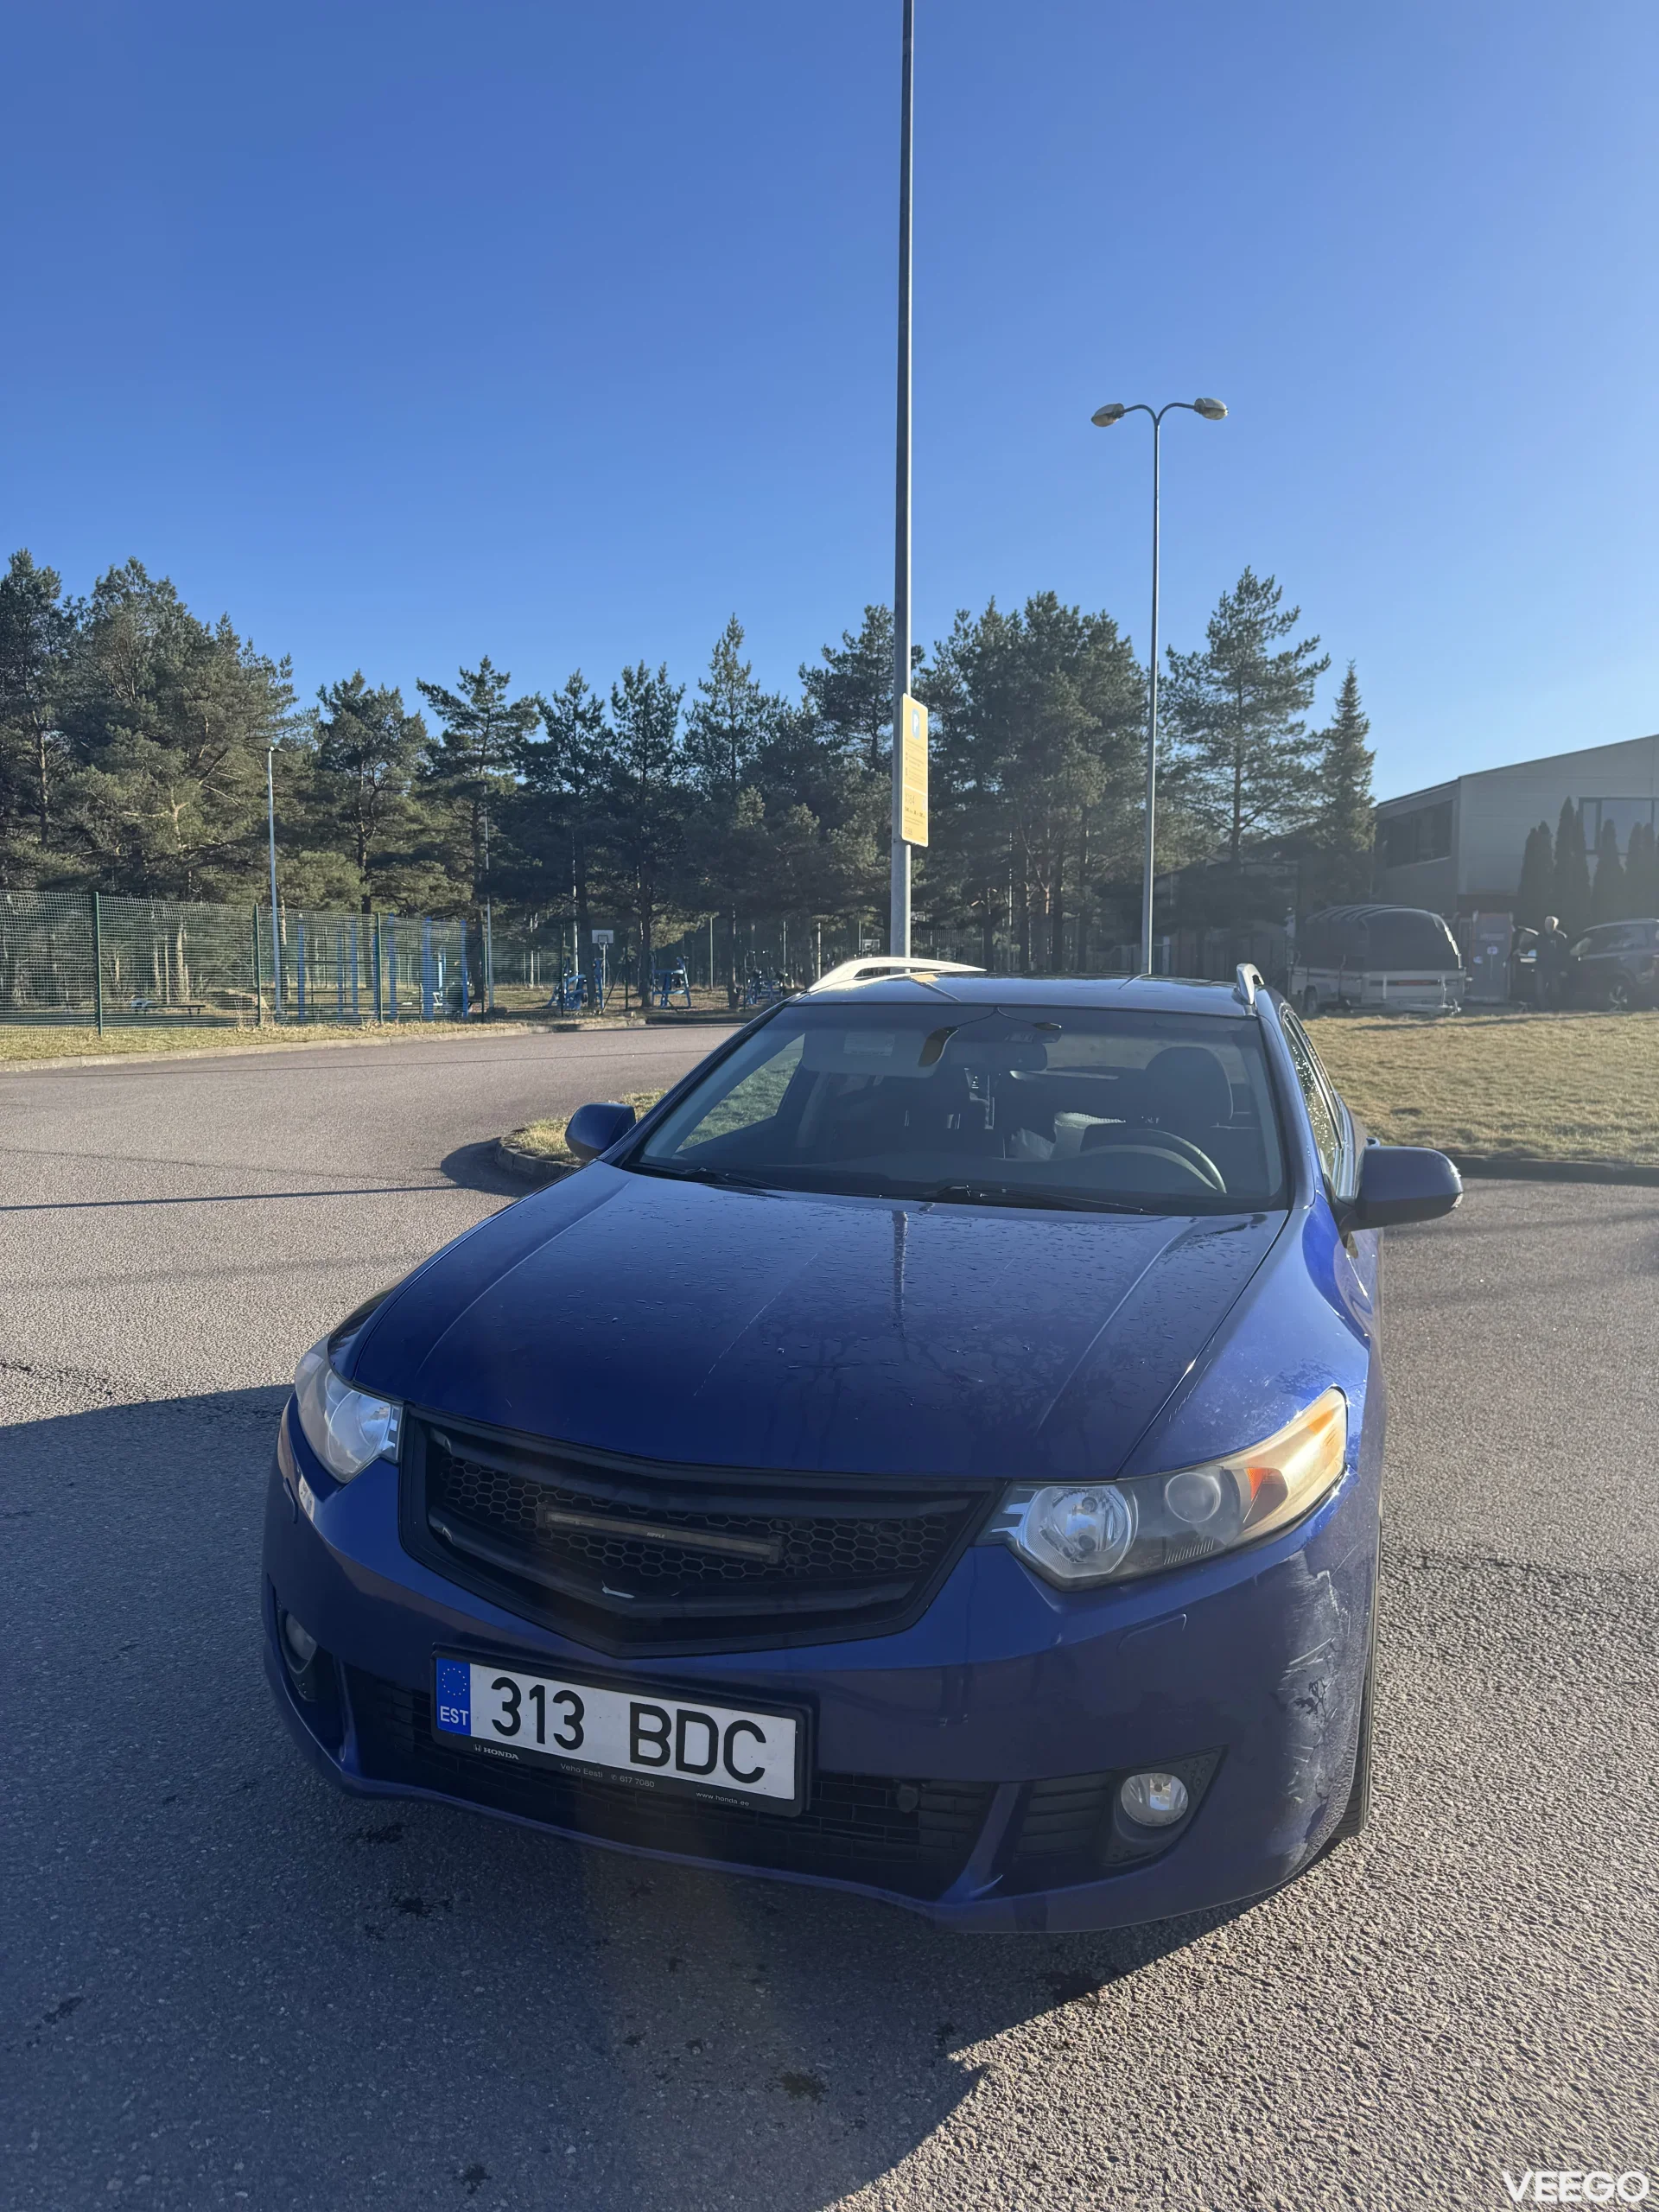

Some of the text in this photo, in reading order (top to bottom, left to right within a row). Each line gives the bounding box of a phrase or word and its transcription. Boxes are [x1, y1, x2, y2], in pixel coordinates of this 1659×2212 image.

[439, 1706, 469, 1726] EST
[491, 1676, 766, 1784] 313 BDC
[483, 1747, 519, 1760] HONDA
[560, 1762, 604, 1778] Veho Eesti
[620, 1775, 655, 1788] 617 7080
[696, 1791, 750, 1807] www.honda.ee
